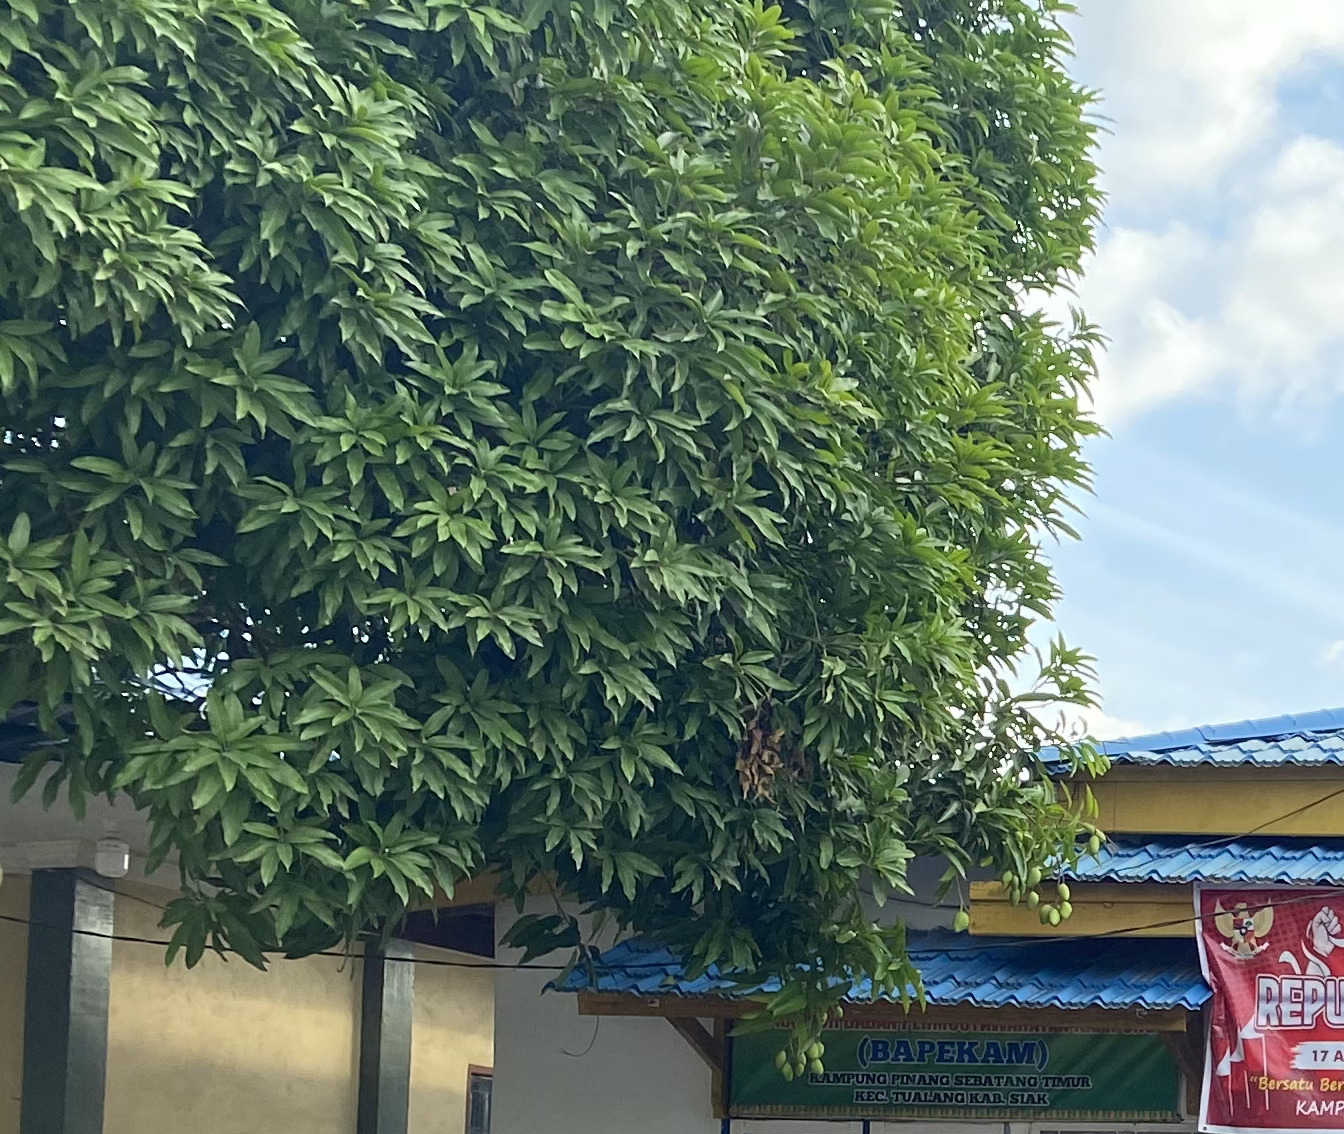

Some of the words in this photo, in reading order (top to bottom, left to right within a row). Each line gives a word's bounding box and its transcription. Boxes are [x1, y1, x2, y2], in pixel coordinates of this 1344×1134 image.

[857, 1034, 1050, 1072] (BAPEKAM)
[1312, 1050, 1330, 1063] 17
[808, 1072, 887, 1086] KAMPUNG
[890, 1072, 951, 1087] PINANG
[954, 1073, 1041, 1088] SEBATANG
[1041, 1075, 1093, 1089] TIMUR
[852, 1089, 889, 1104] KEC.
[890, 1090, 968, 1105] TUALANG
[968, 1091, 1006, 1105] KAB.
[1007, 1091, 1050, 1106] SIAK
